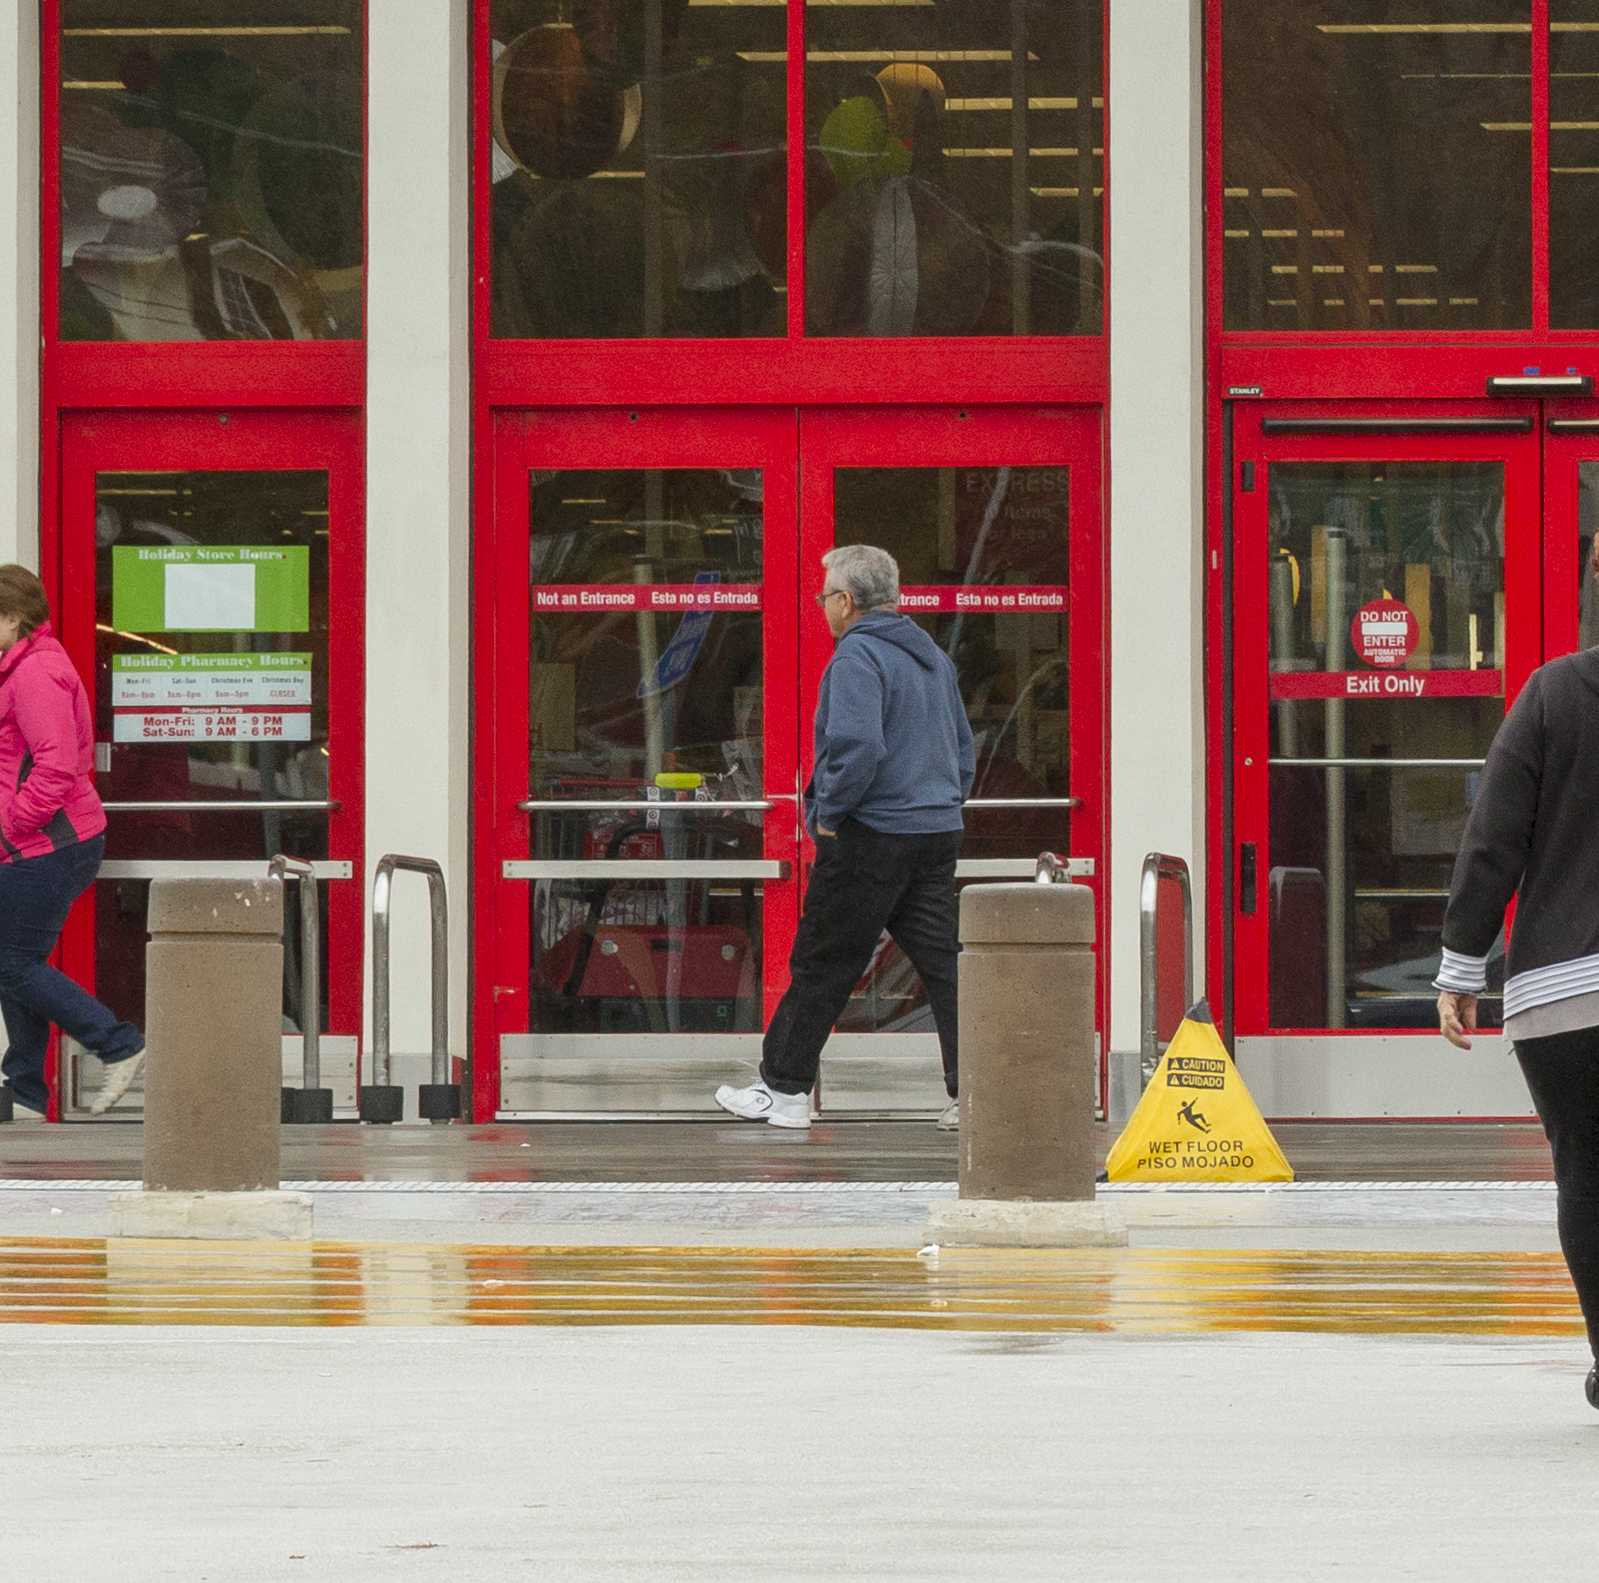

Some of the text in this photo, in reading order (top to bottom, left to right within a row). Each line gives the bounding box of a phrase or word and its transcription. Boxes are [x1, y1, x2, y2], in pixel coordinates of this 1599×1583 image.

[1229, 387, 1260, 395] STANLEY
[965, 471, 1068, 494] EXRESS
[138, 548, 193, 562] Holiday
[196, 549, 235, 560] Store
[536, 591, 635, 605] Not an Entrance
[651, 591, 759, 605] Esta no es Entrada
[898, 593, 941, 606] trance
[955, 593, 1063, 606] Esta no es Entrada
[1360, 611, 1408, 622] DO NOT
[1363, 636, 1406, 647] ENTER
[1363, 648, 1406, 656] AUTOMATIC
[121, 655, 175, 669] Holiday
[180, 654, 253, 669] Pharmacy
[1374, 655, 1395, 663] DOOR
[171, 677, 197, 685] Sat-Sun
[1346, 675, 1425, 696] Exit Only
[269, 690, 296, 698] CLOSED
[143, 717, 195, 726] Mon-Fri:
[204, 717, 213, 726] 9
[217, 716, 236, 726] AM
[251, 716, 259, 725] 9
[263, 716, 283, 725] PM
[143, 727, 195, 737] Sat-Sun:
[204, 727, 213, 736] 9
[217, 727, 236, 736] AM
[251, 727, 259, 736] 6
[263, 726, 283, 736] PM
[1182, 1058, 1224, 1072] CAUTION
[1181, 1074, 1223, 1088] CUIDADO
[1149, 1140, 1243, 1154] WET FLOOR
[1137, 1155, 1254, 1169] PISO MOJADO
